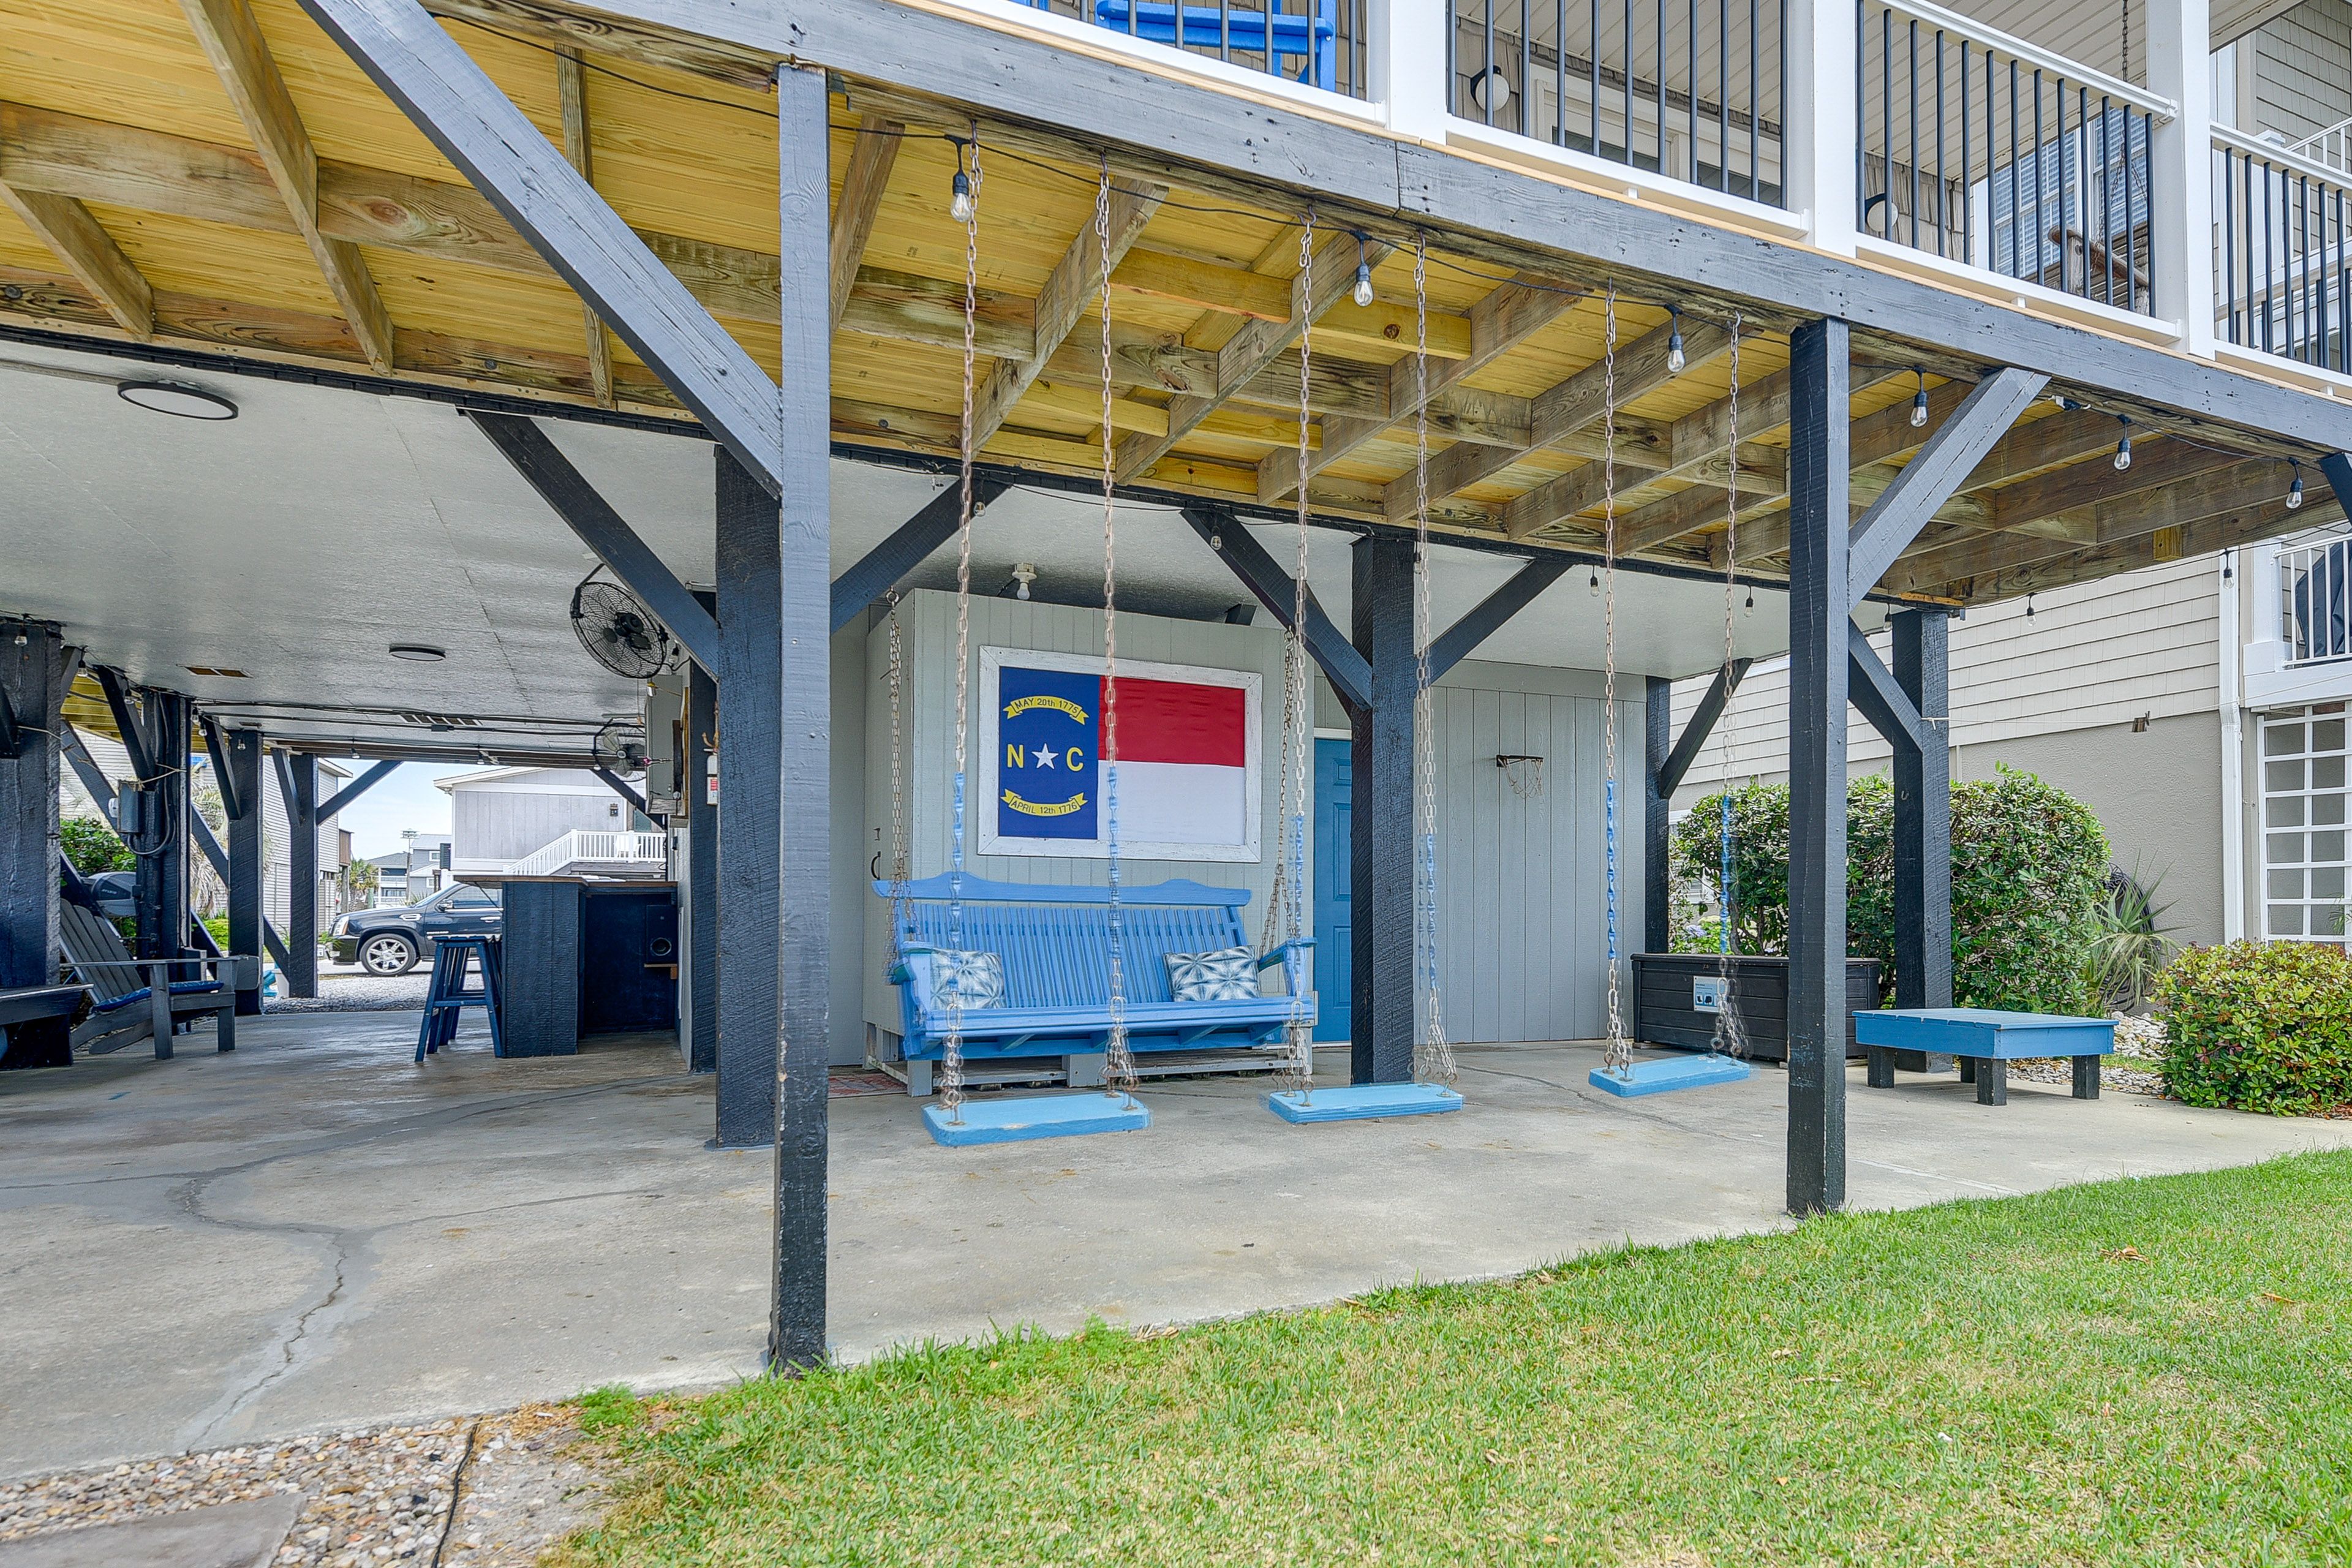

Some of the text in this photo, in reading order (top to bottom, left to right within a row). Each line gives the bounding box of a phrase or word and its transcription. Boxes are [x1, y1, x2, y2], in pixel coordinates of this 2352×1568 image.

[1014, 698, 1034, 709] MAY
[1059, 700, 1078, 714] 1775
[1007, 744, 1084, 772] N C
[1011, 801, 1036, 814] APRIL
[1058, 802, 1077, 814] 1776
